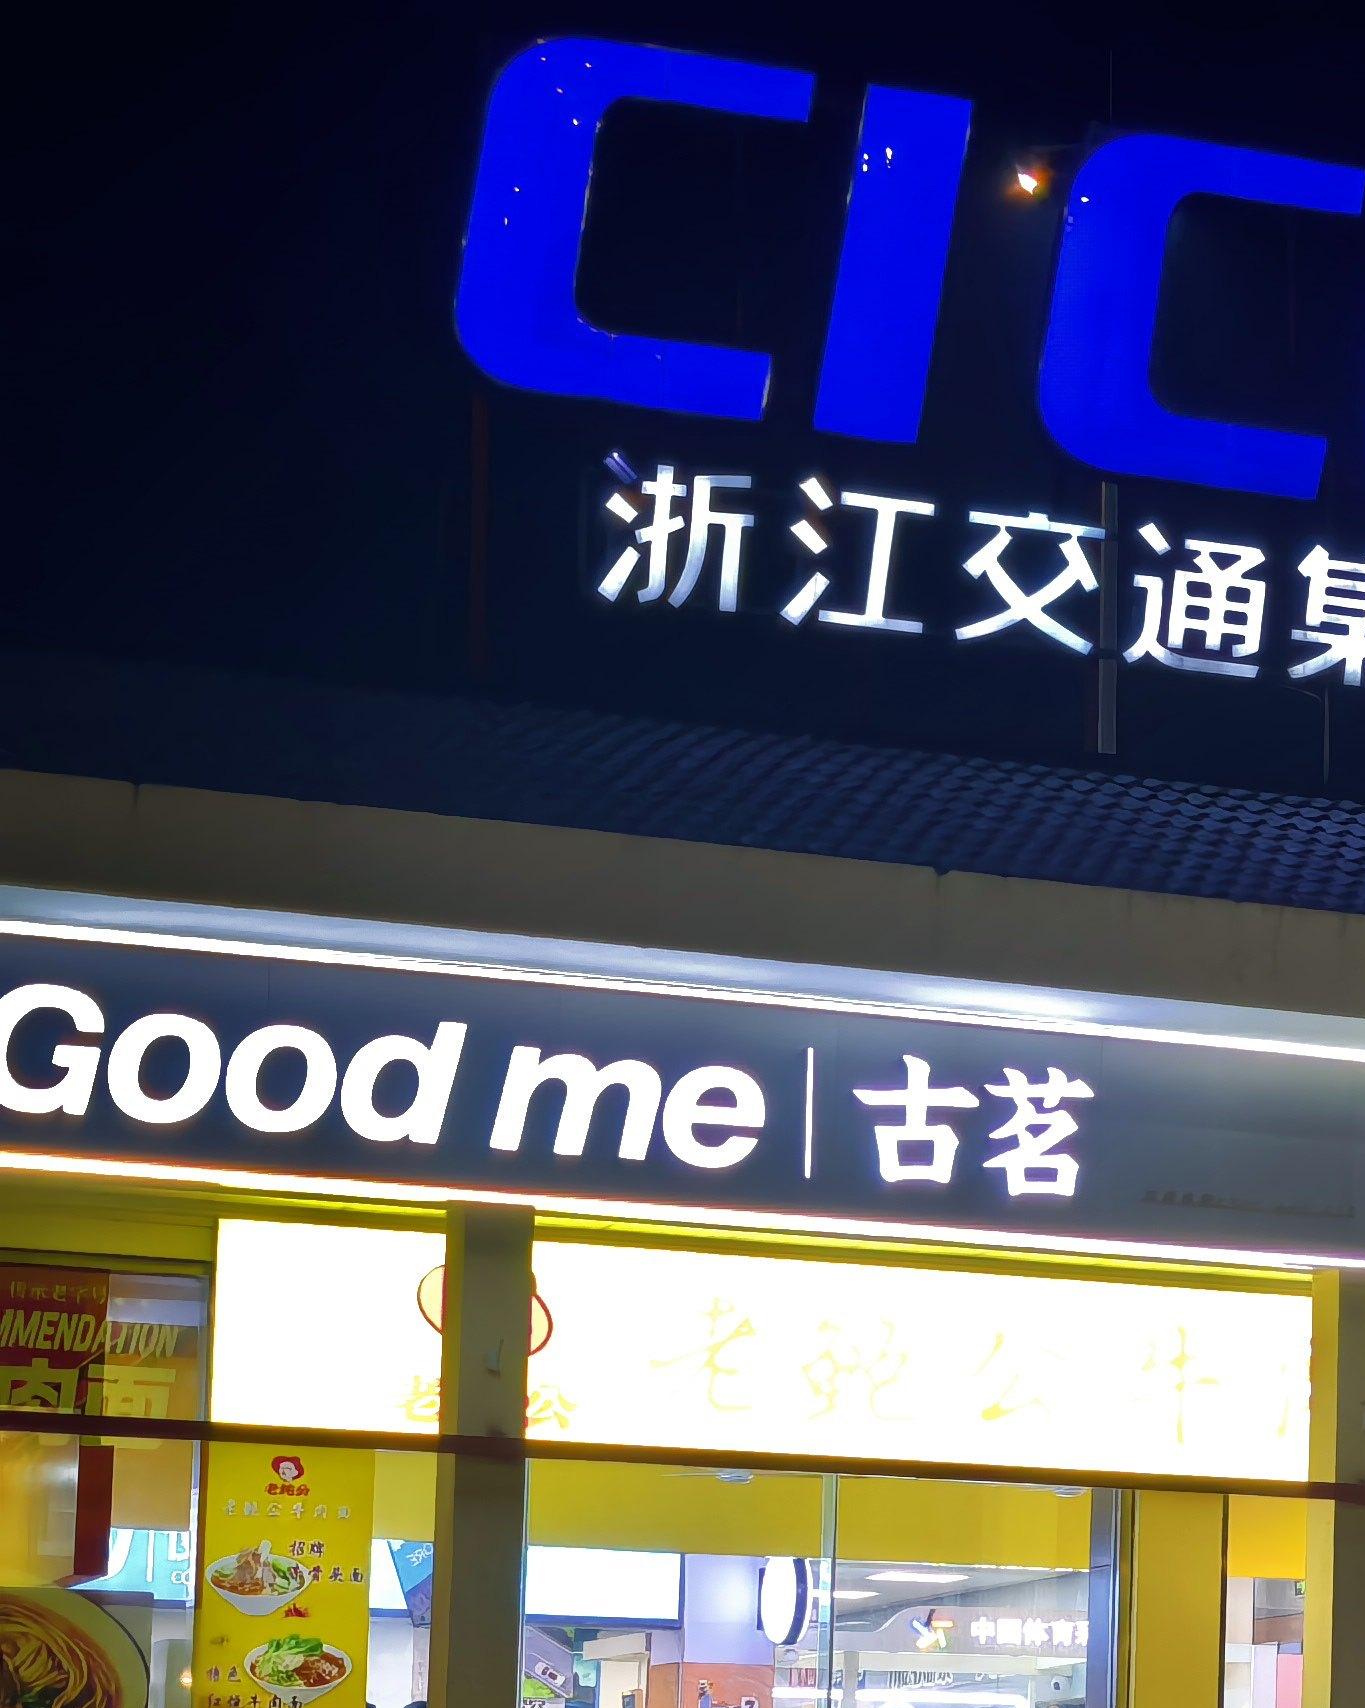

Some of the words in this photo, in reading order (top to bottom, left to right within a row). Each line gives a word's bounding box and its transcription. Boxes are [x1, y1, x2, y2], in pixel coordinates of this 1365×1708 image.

[0, 983, 468, 1145] Good
[489, 1045, 766, 1169] me
[853, 1054, 1096, 1197] 古茗
